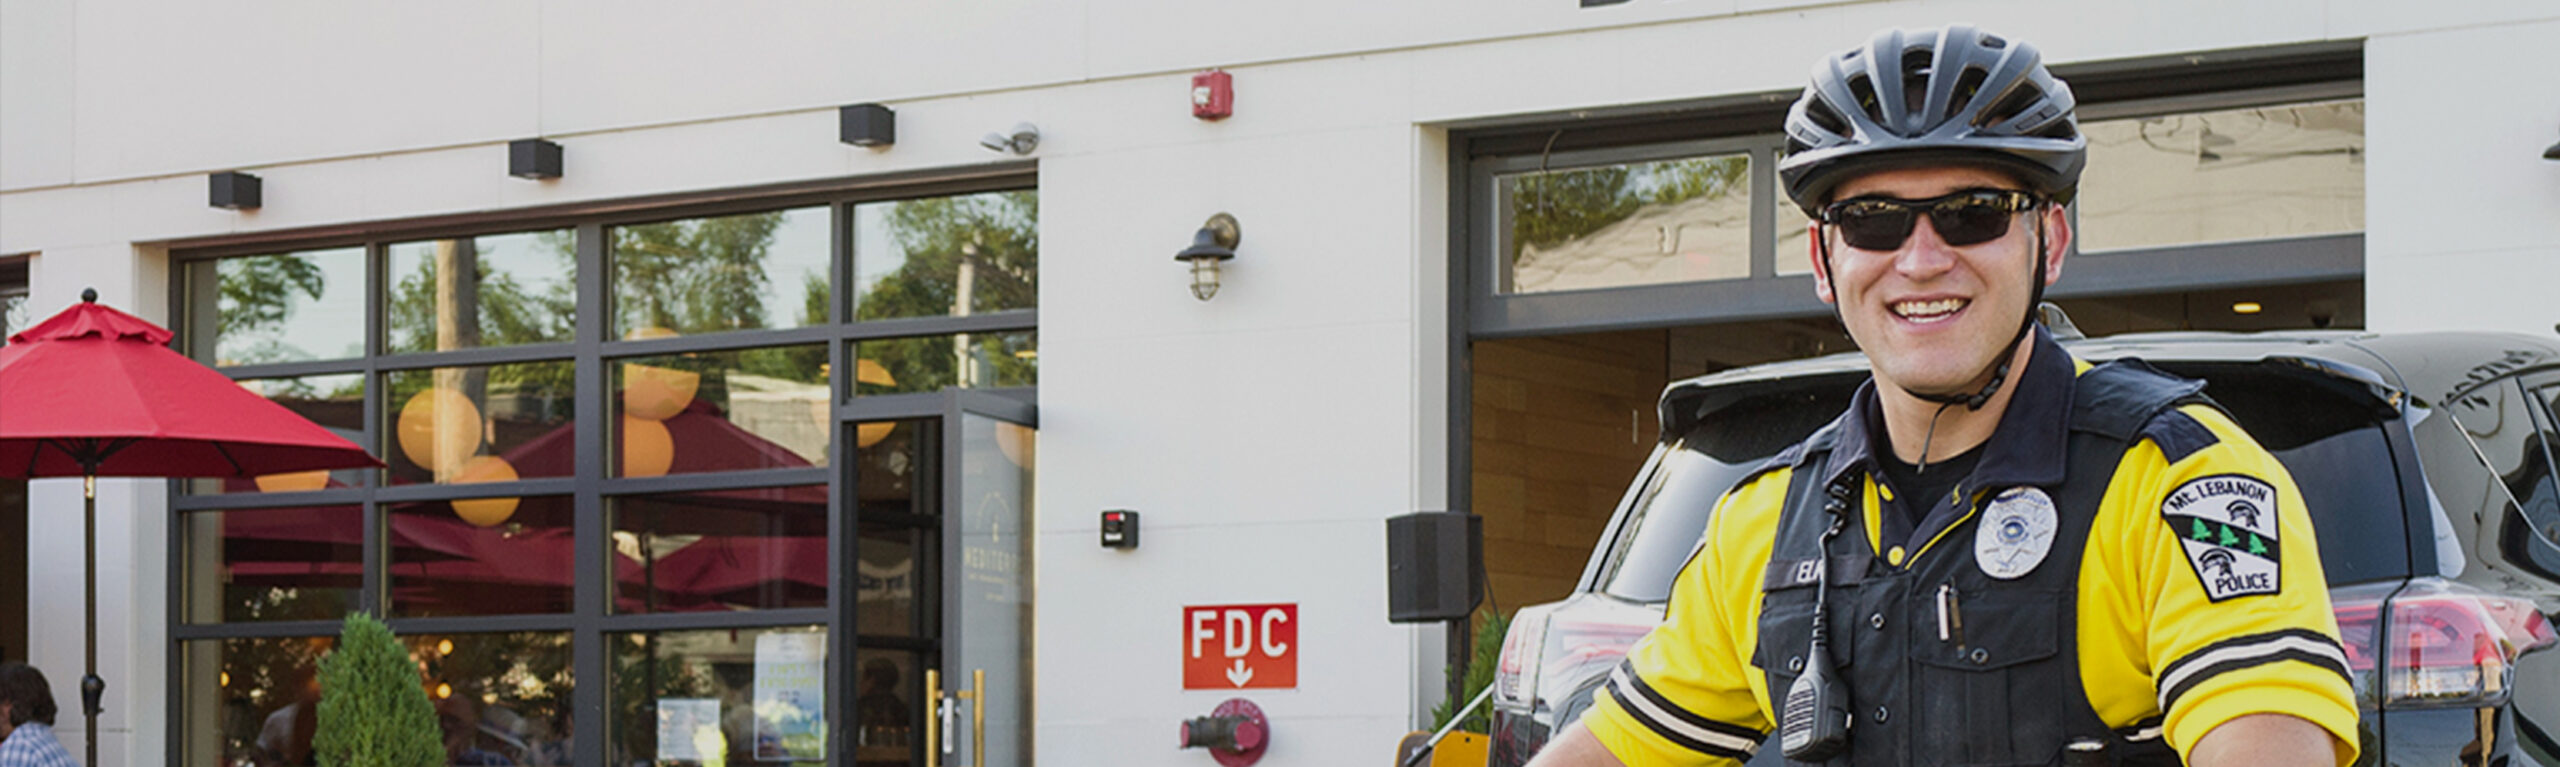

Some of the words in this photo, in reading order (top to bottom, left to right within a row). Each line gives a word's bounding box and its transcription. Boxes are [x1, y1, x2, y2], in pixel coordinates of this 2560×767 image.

[2196, 481, 2267, 502] LEBANON
[2215, 573, 2270, 594] POLICE
[1191, 607, 1289, 659] FDC
